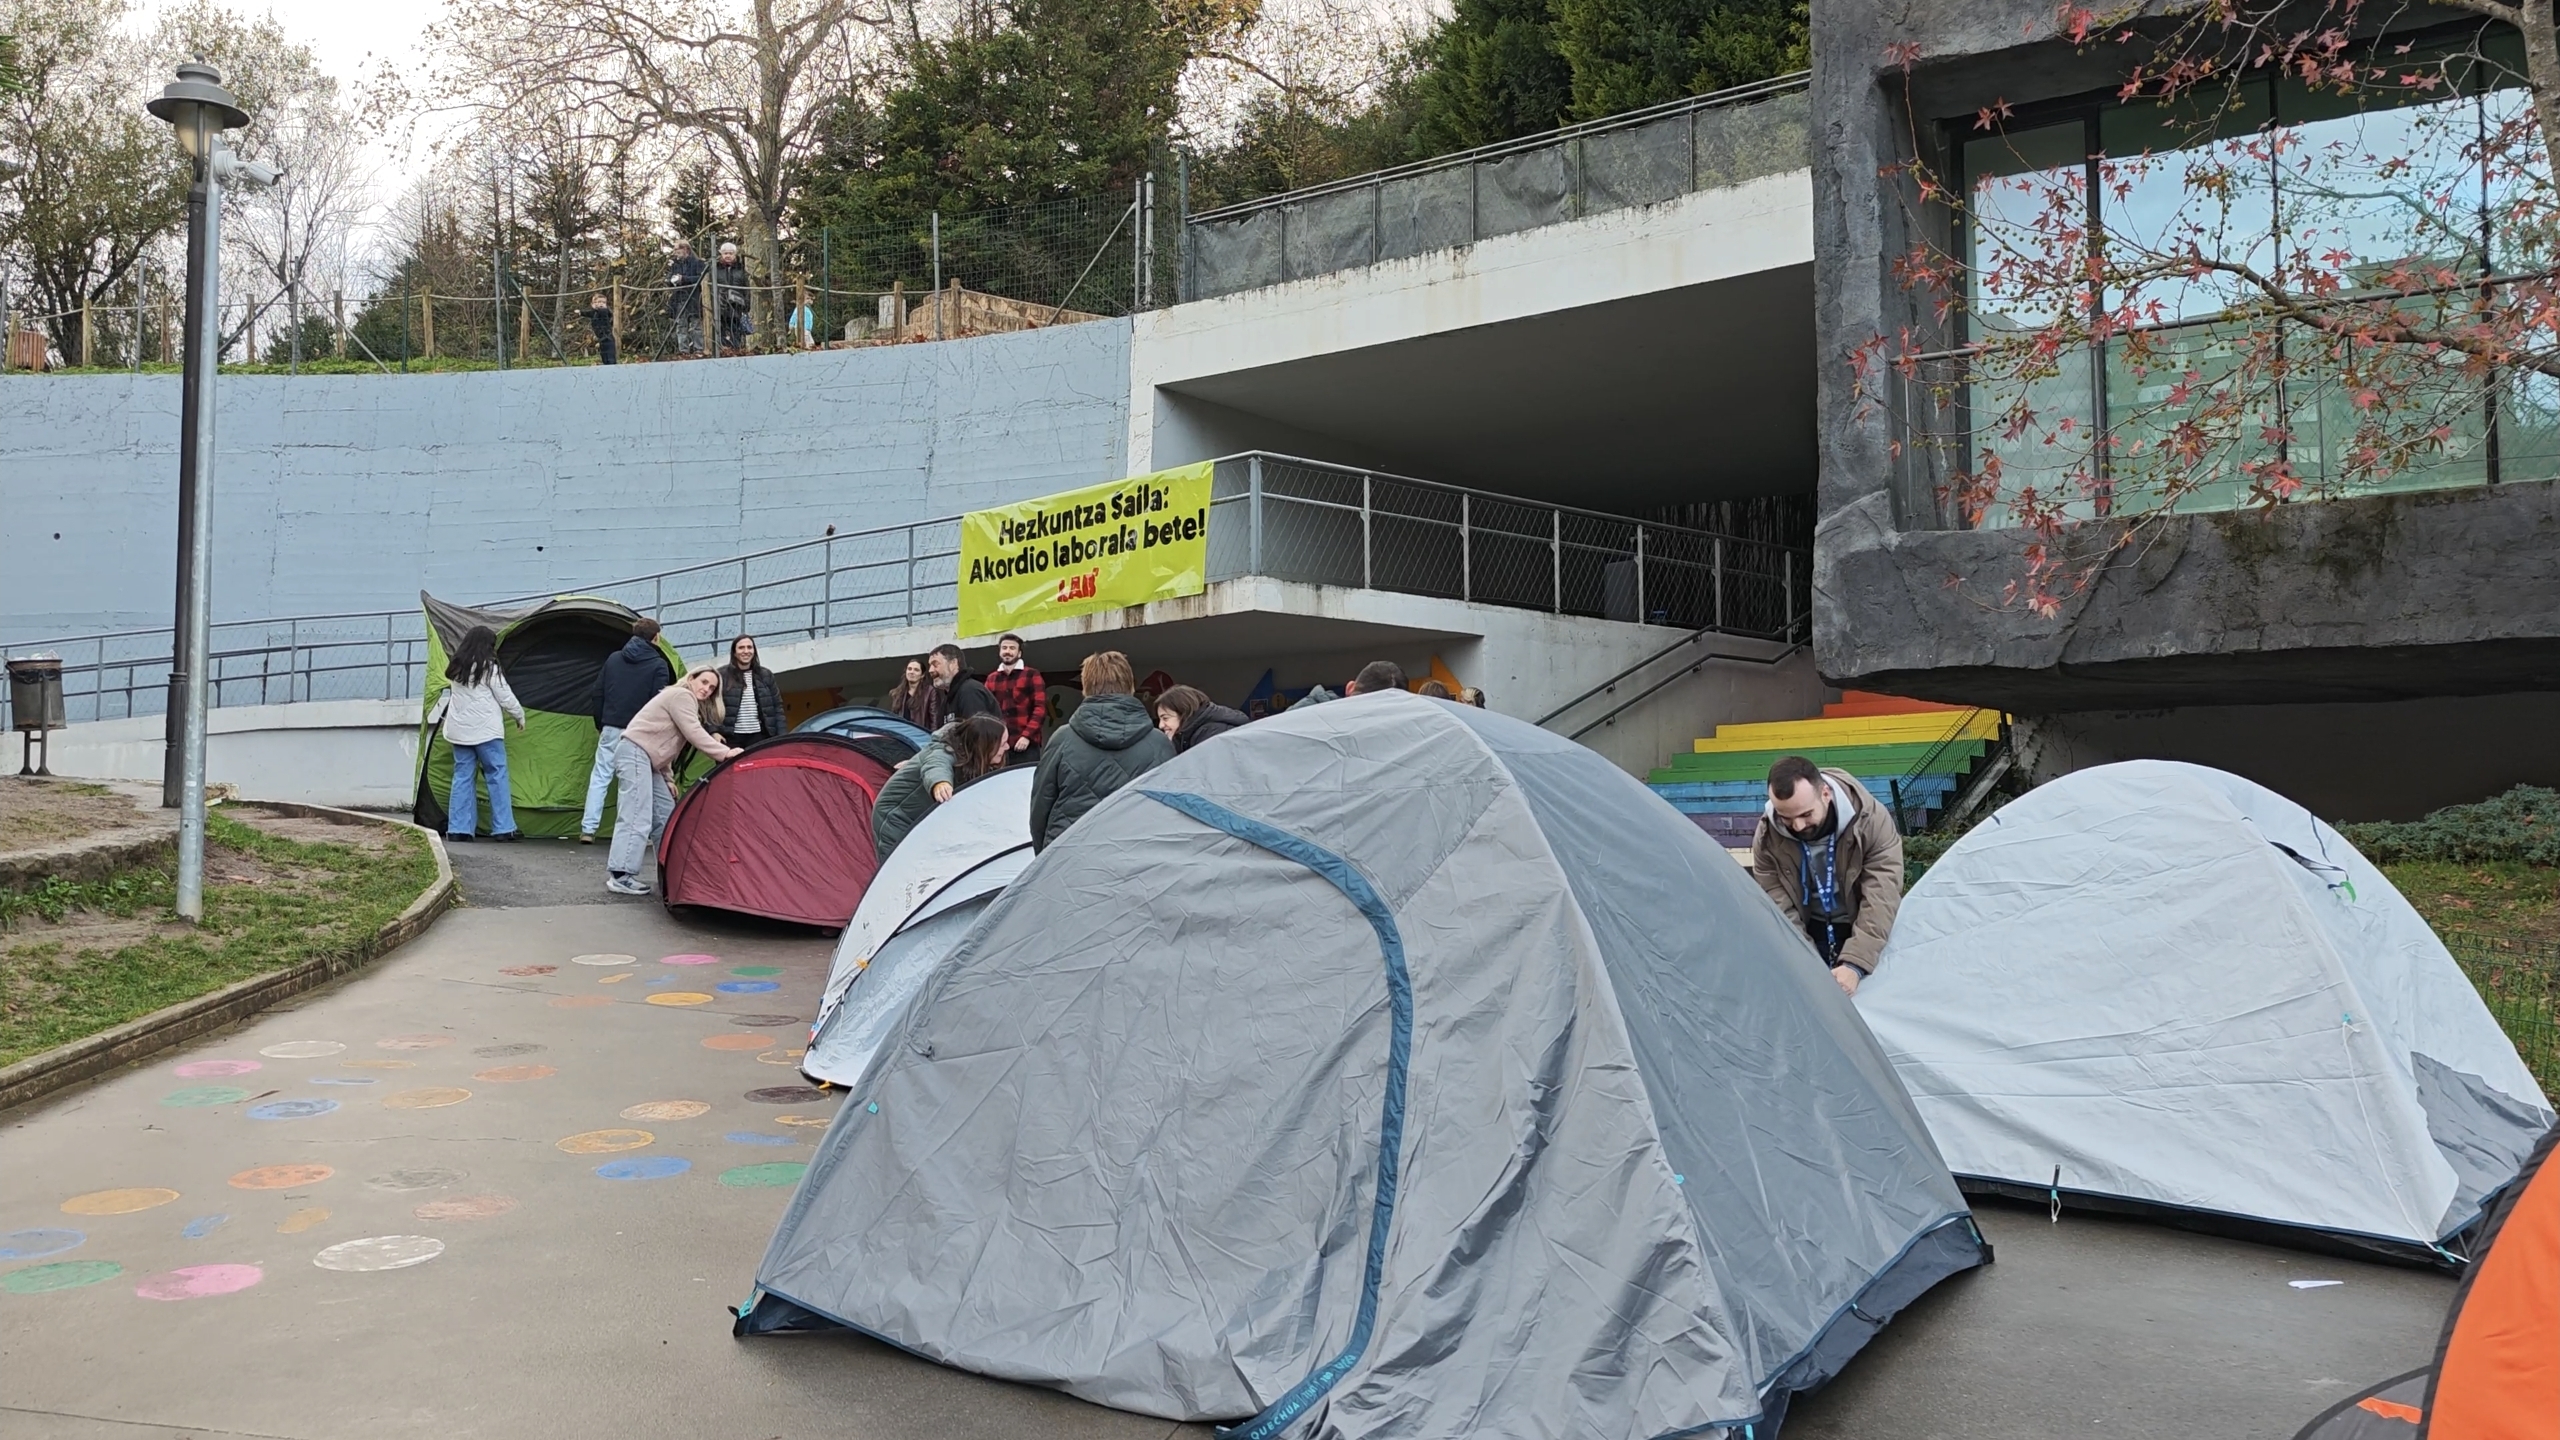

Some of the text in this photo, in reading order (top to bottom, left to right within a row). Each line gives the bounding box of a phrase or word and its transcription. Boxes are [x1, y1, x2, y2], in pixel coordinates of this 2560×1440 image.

[969, 508, 1205, 584] Akordio laborala bete!
[999, 484, 1169, 546] Hezkuntza Saila:
[1250, 1400, 1300, 1440] QUECHUA
